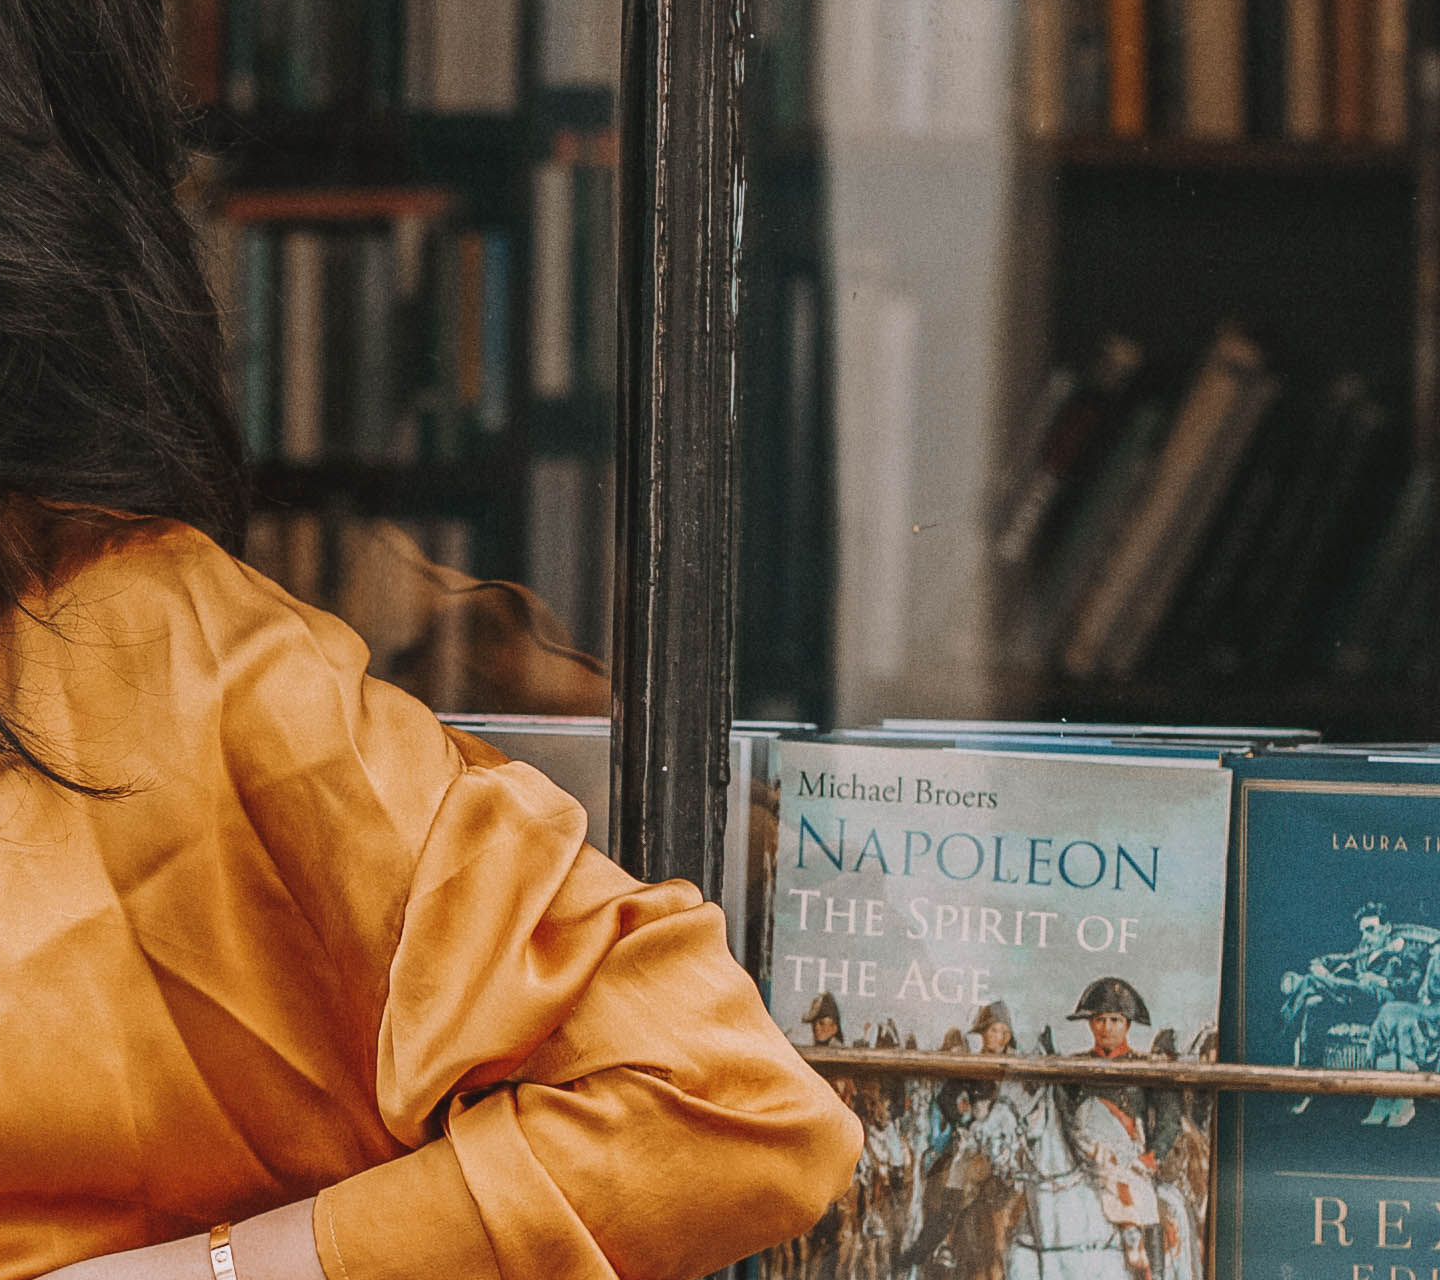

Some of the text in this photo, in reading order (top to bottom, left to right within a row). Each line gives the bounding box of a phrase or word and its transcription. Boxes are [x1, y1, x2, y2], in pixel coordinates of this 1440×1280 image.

[798, 770, 998, 810] Michael Broers
[795, 814, 1160, 894] NAPOLEON
[1332, 832, 1408, 852] LAURA
[788, 888, 1139, 954] THE SPIRIT OF
[784, 955, 992, 1006] THE AGE
